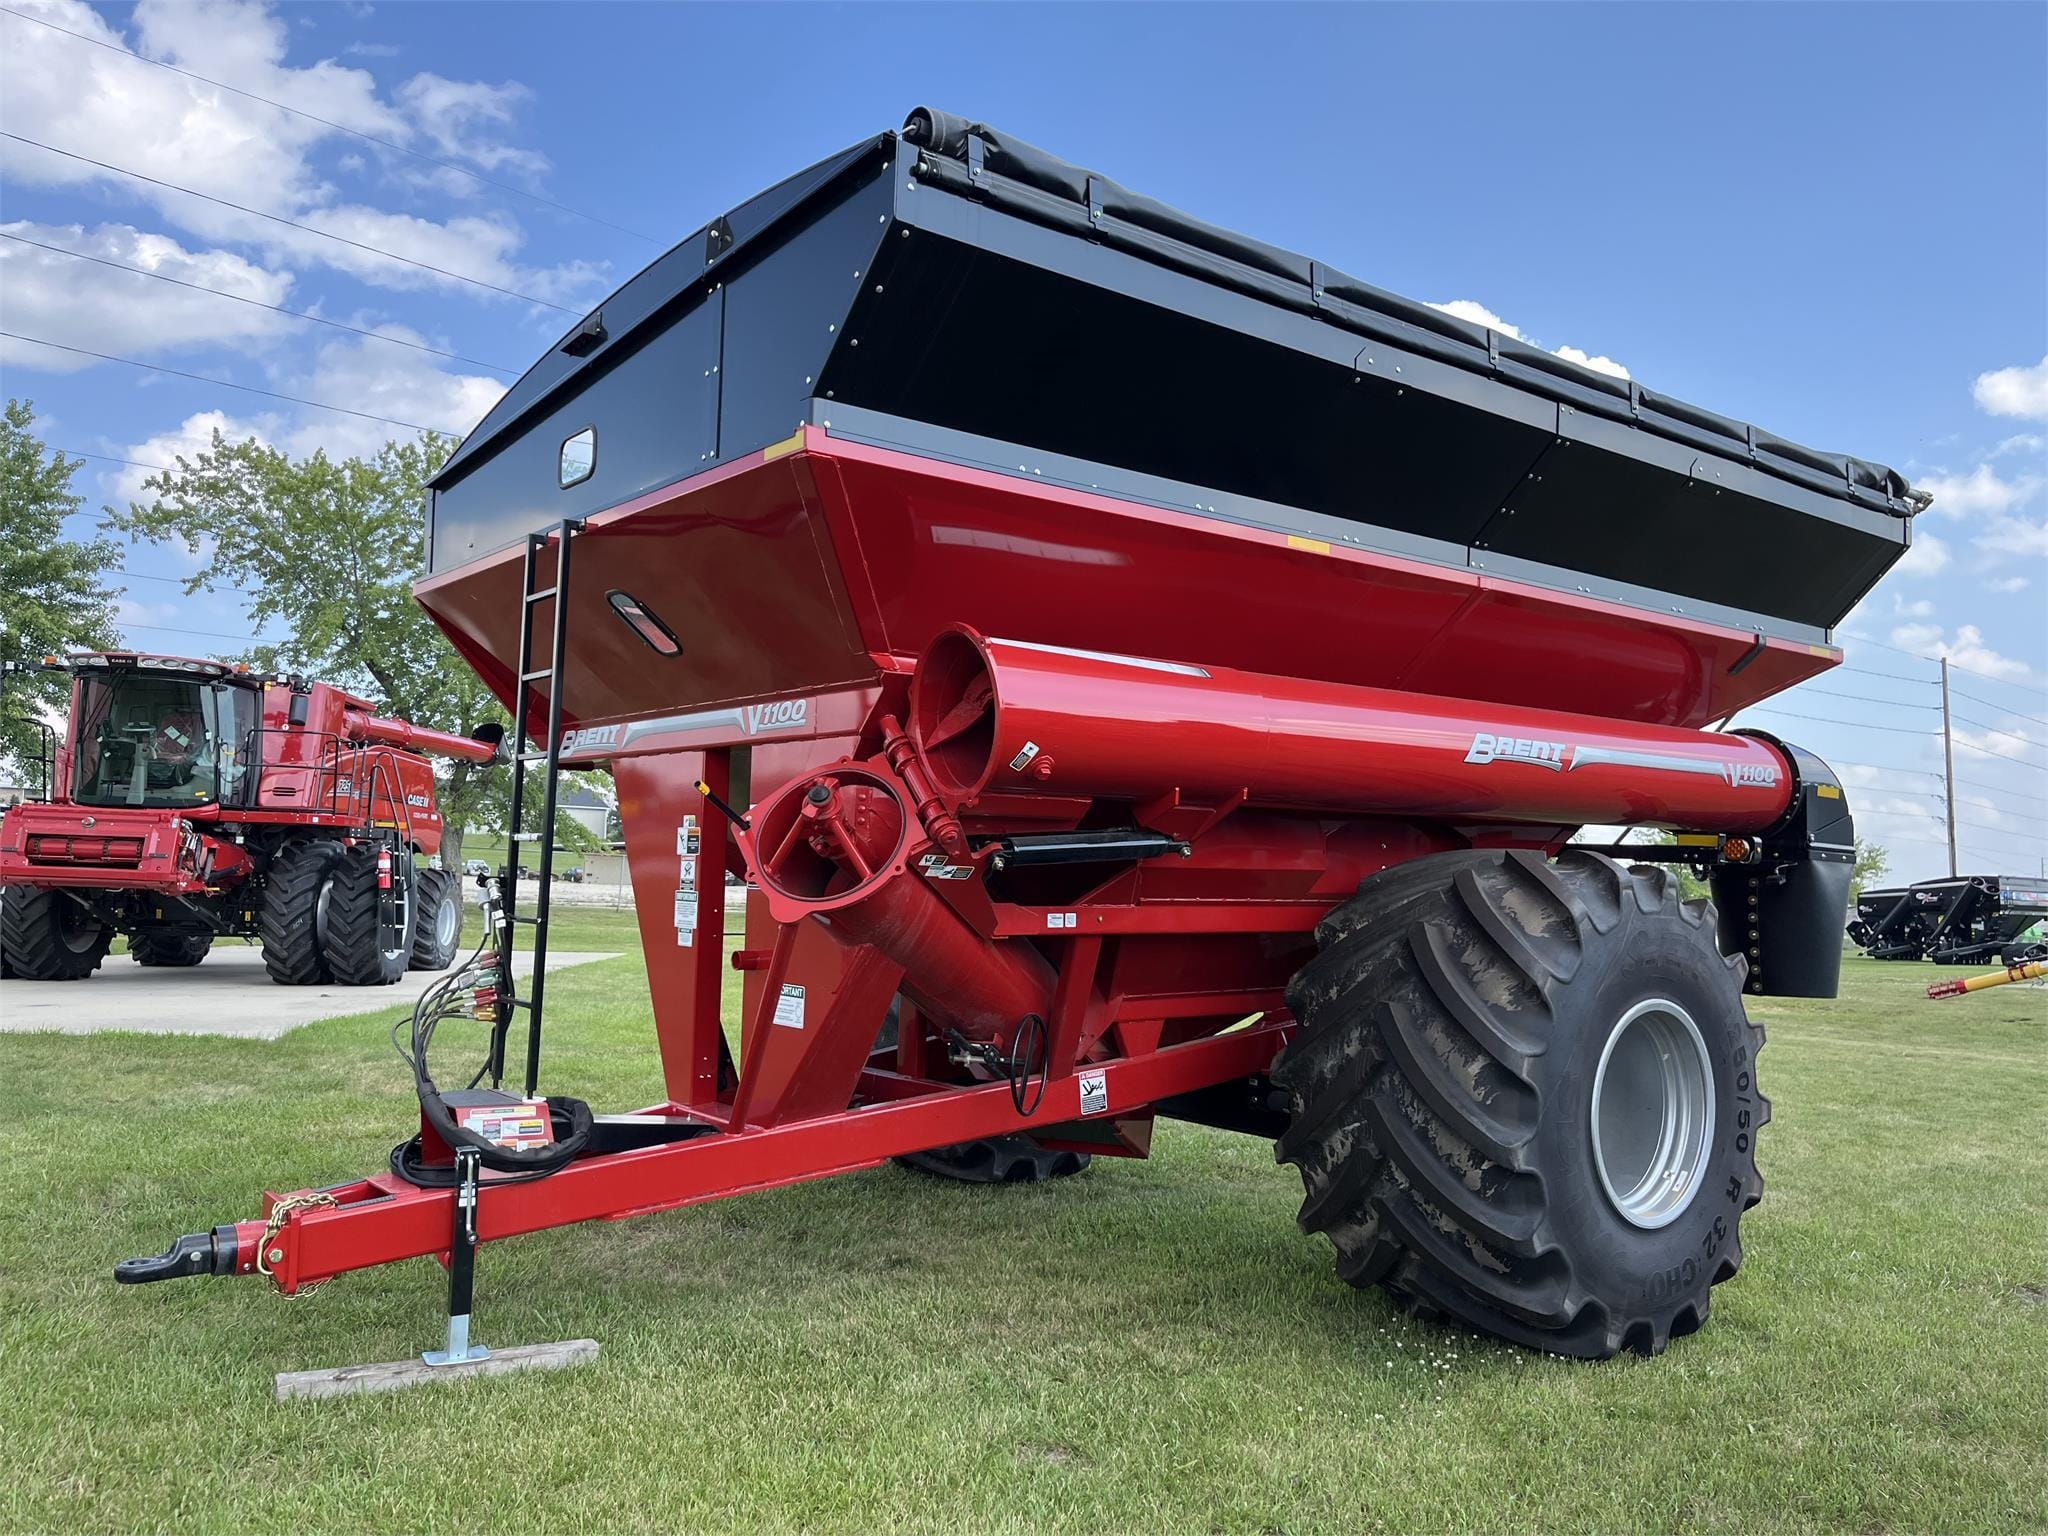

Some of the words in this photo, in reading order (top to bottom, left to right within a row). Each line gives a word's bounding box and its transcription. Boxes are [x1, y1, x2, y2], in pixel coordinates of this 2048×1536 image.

[558, 725, 622, 760] BRENT
[747, 699, 807, 736] V1100
[1464, 732, 1566, 766] BRENT
[1728, 762, 1775, 788] V1100
